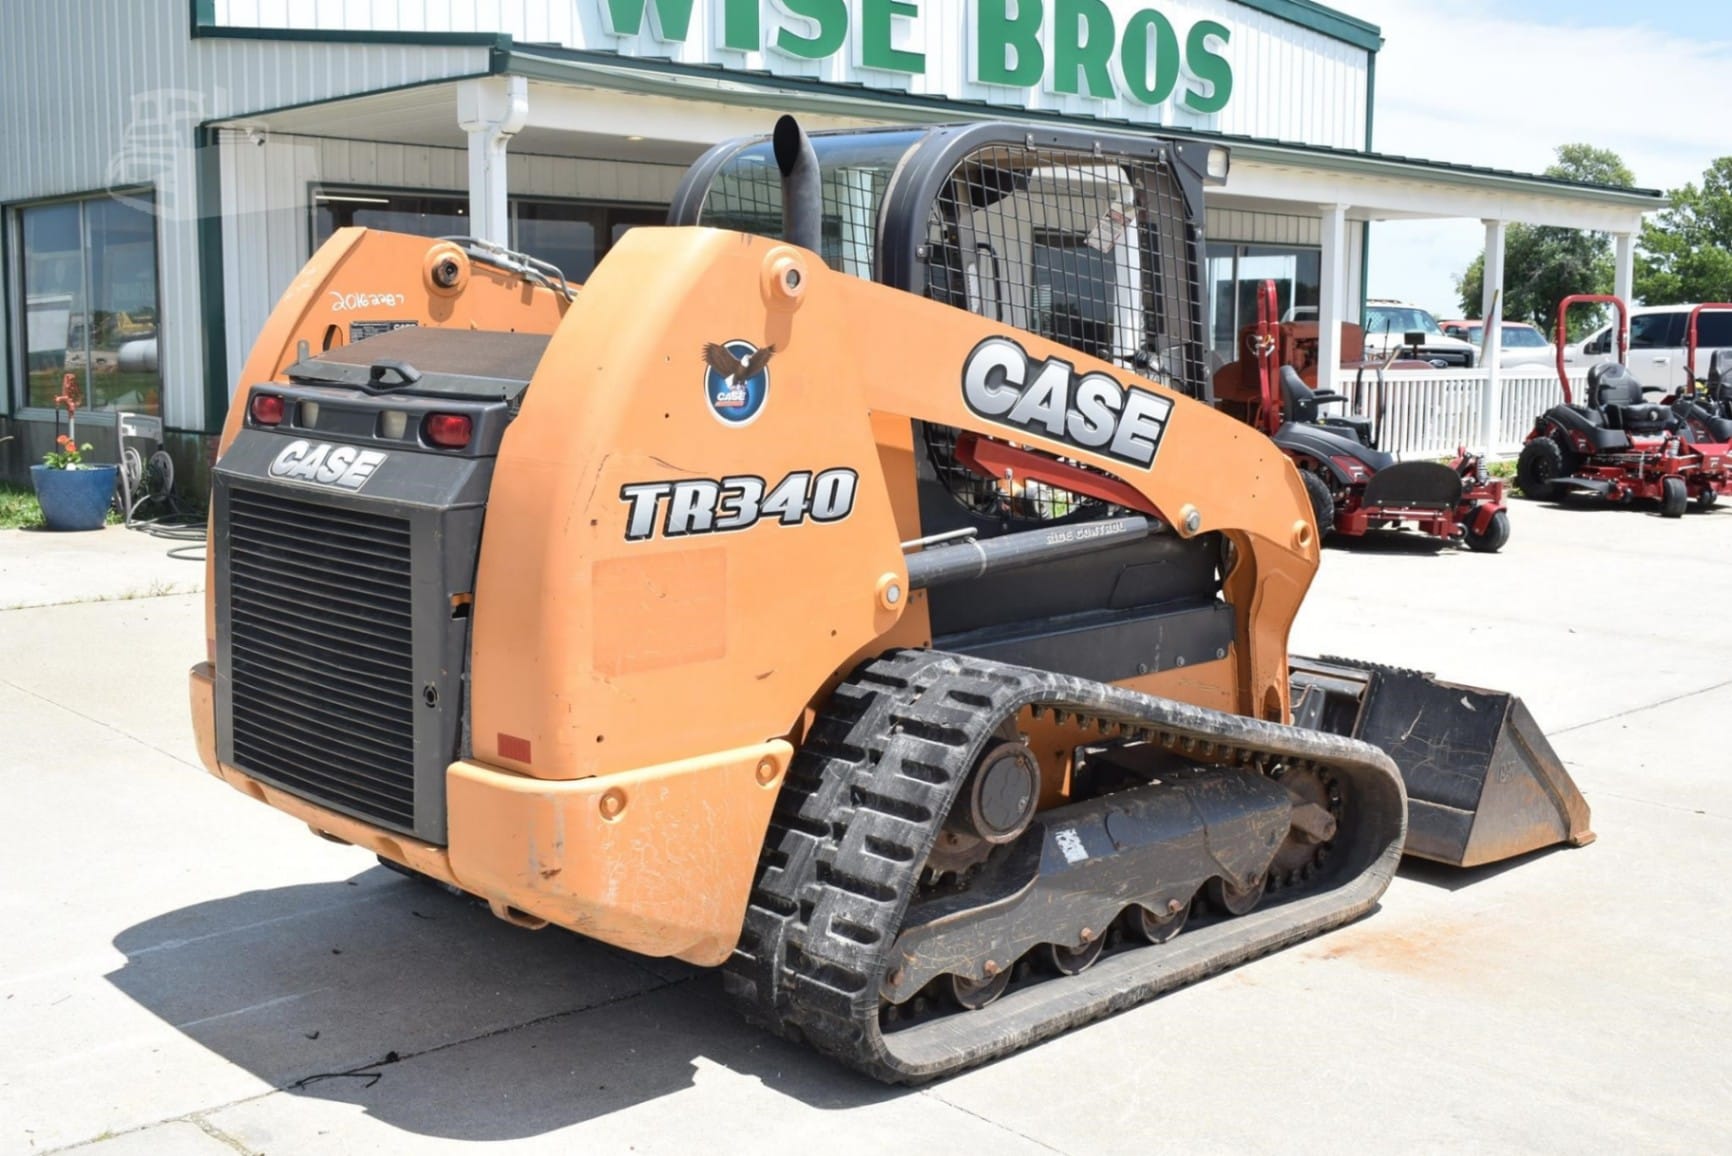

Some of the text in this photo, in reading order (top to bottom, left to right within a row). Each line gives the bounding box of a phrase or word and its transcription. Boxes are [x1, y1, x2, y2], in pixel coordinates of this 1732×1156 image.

[970, 0, 1233, 114] BROS
[964, 336, 1172, 464] CASE
[272, 440, 387, 488] CASE
[620, 467, 858, 541] TR340
